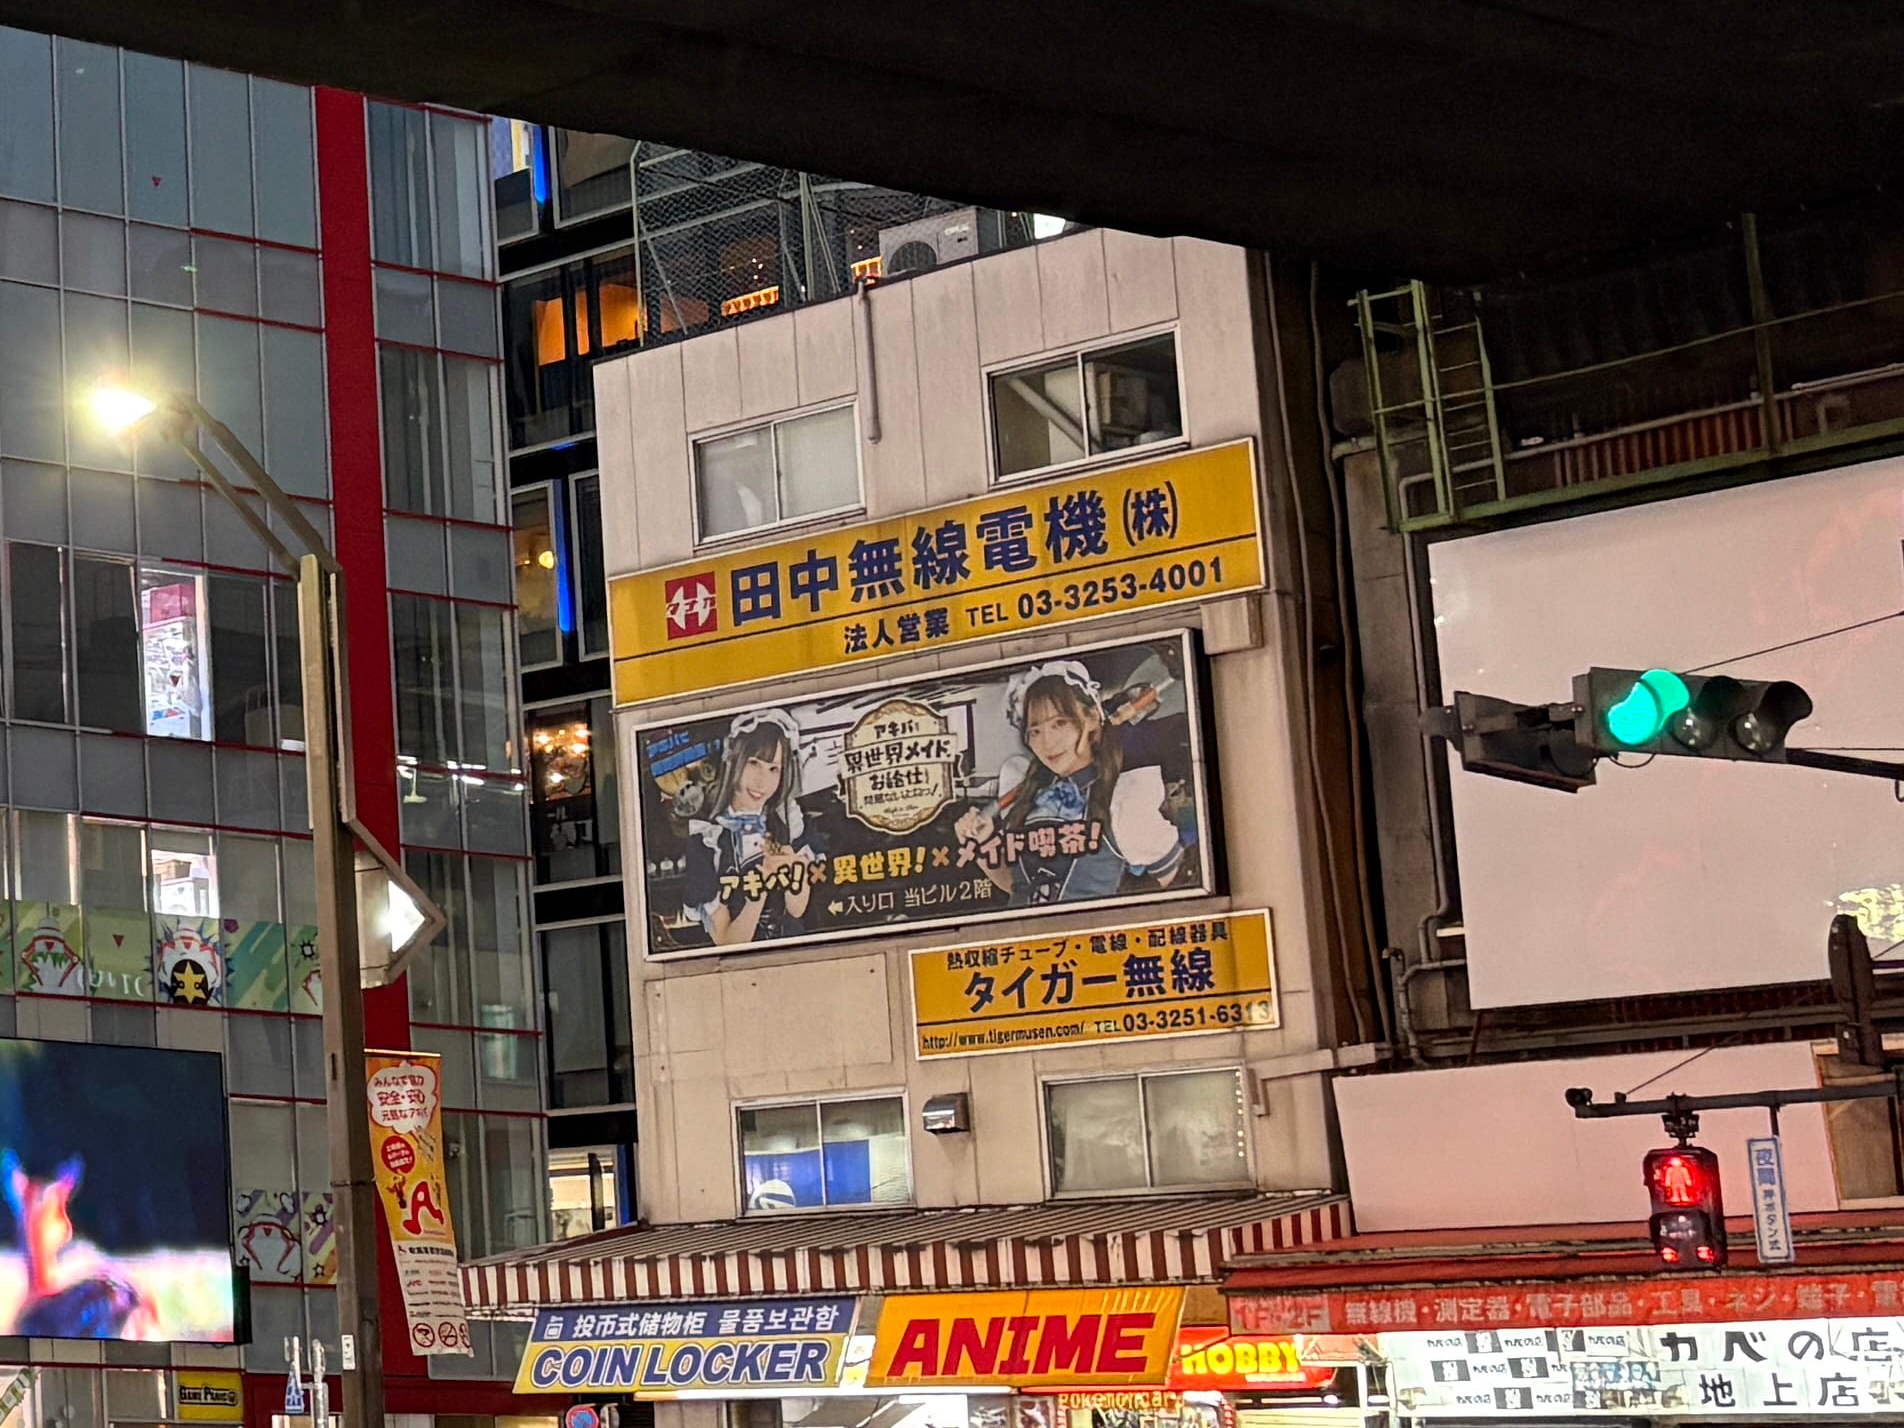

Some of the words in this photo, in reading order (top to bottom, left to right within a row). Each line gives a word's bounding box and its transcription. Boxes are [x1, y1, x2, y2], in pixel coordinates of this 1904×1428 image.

[844, 608, 948, 654] 法人営業
[966, 602, 1009, 627] TEL
[1018, 556, 1224, 620] 03-3253-4001
[844, 893, 895, 914] 入り口
[964, 948, 1215, 1014] タイガー無線
[922, 1022, 1085, 1051] http://www.tigermusen.com/
[1094, 1019, 1121, 1035] TEL
[1123, 999, 1273, 1034] 03-3251-6313
[571, 1311, 708, 1339] 投币式储物柜
[718, 1305, 840, 1336] 물품보관함
[885, 1313, 1158, 1377] ANIME
[533, 1344, 643, 1388] COIN
[642, 1339, 831, 1387] LOCKER
[1700, 1372, 1860, 1409] 地上店
